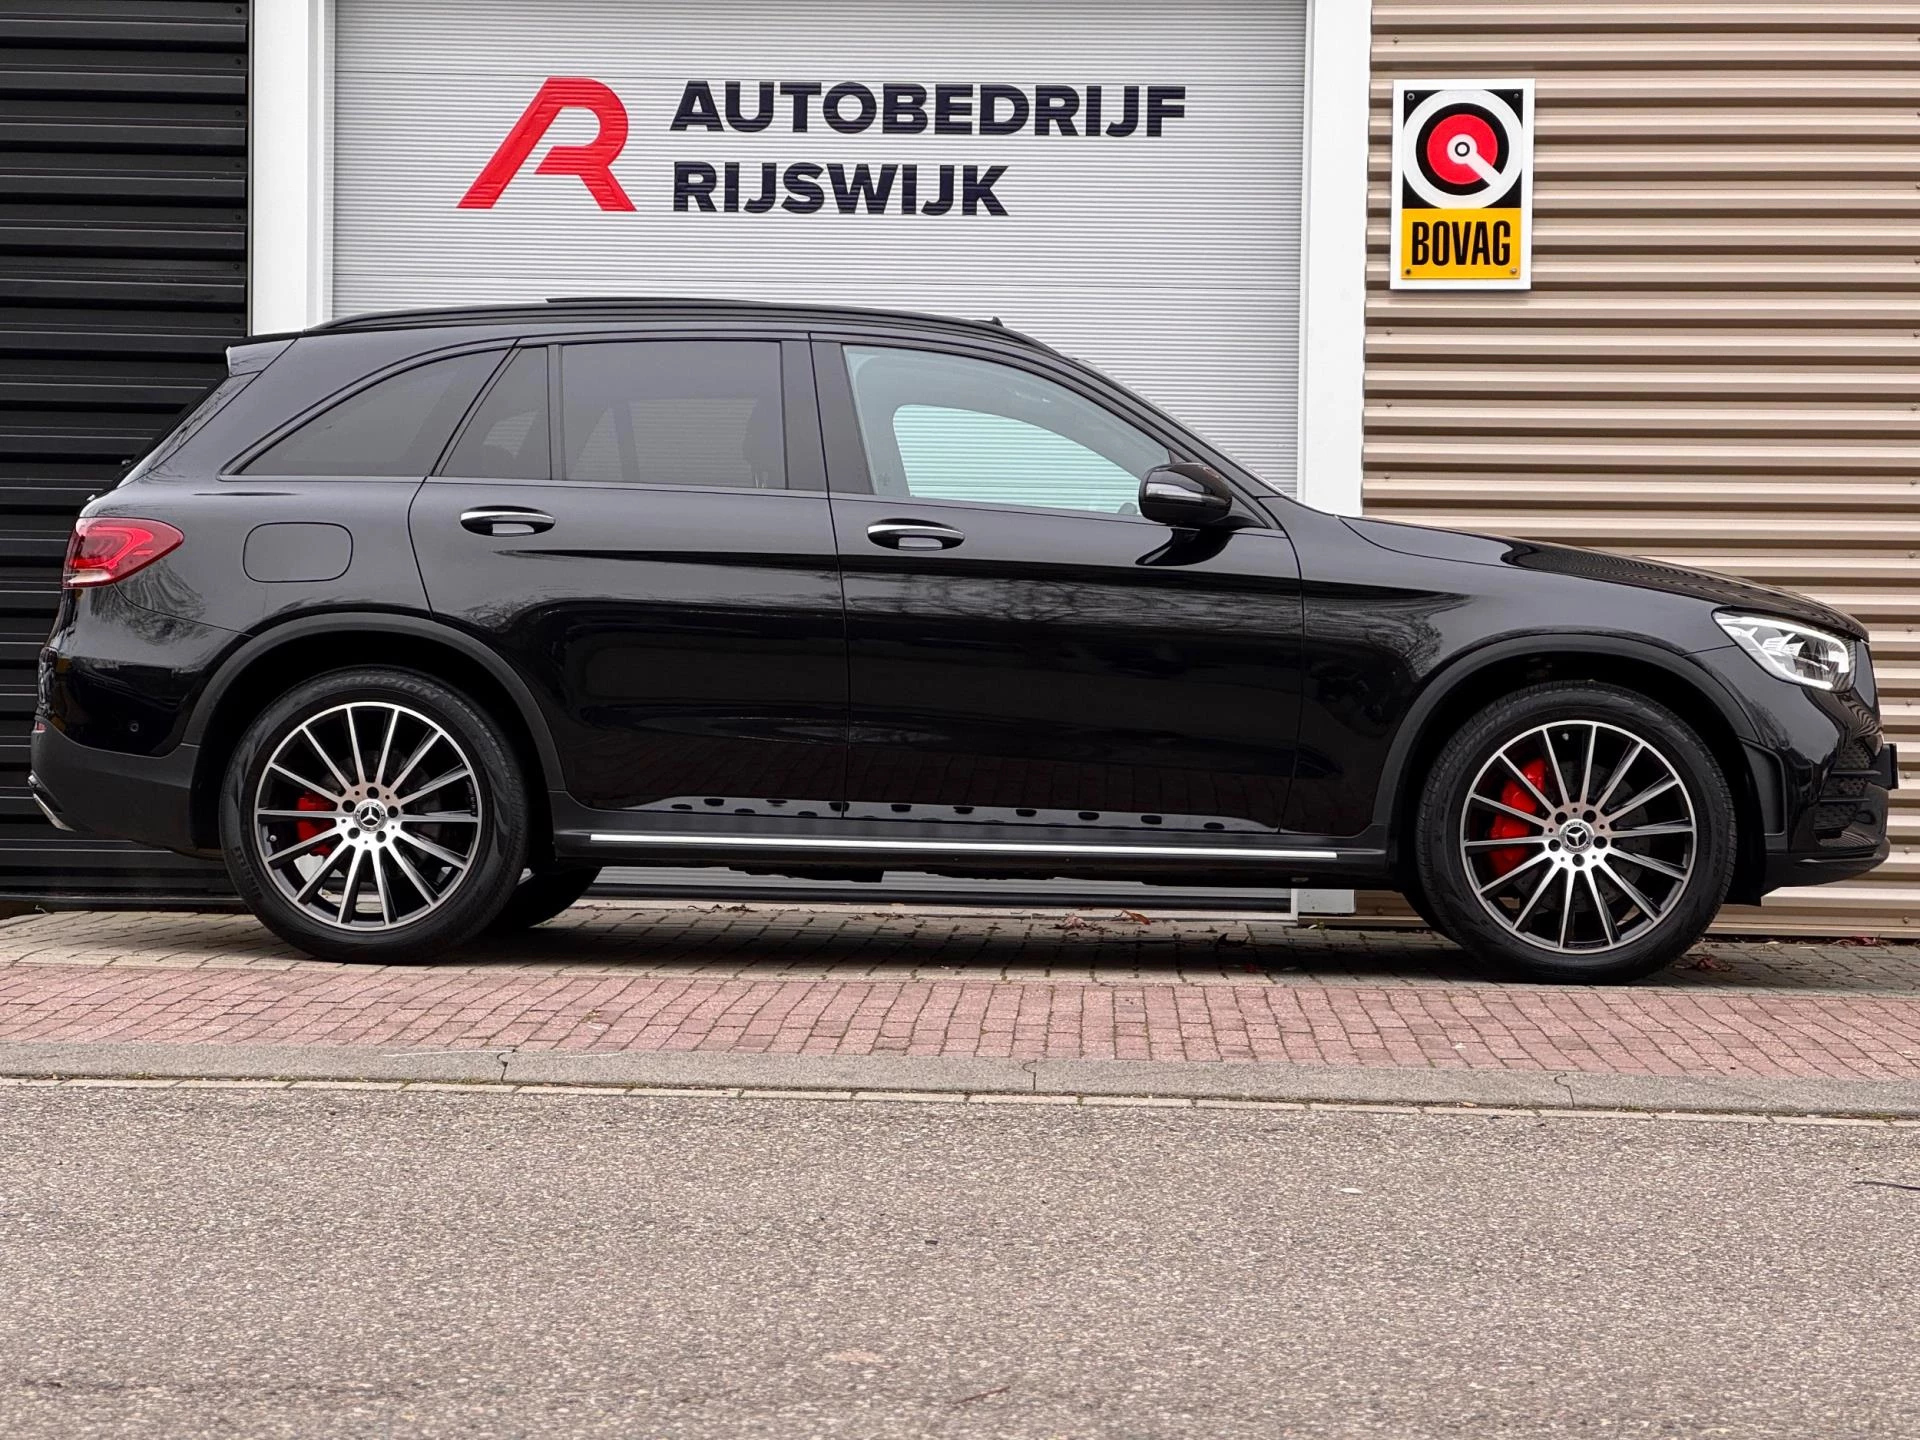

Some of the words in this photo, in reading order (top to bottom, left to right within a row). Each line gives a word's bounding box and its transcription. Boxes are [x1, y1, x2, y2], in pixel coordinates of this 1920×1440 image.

[669, 80, 1186, 138] AUTOBEDRIJF
[673, 161, 1010, 217] RIJSWIJK
[1411, 220, 1511, 266] BOVAG
